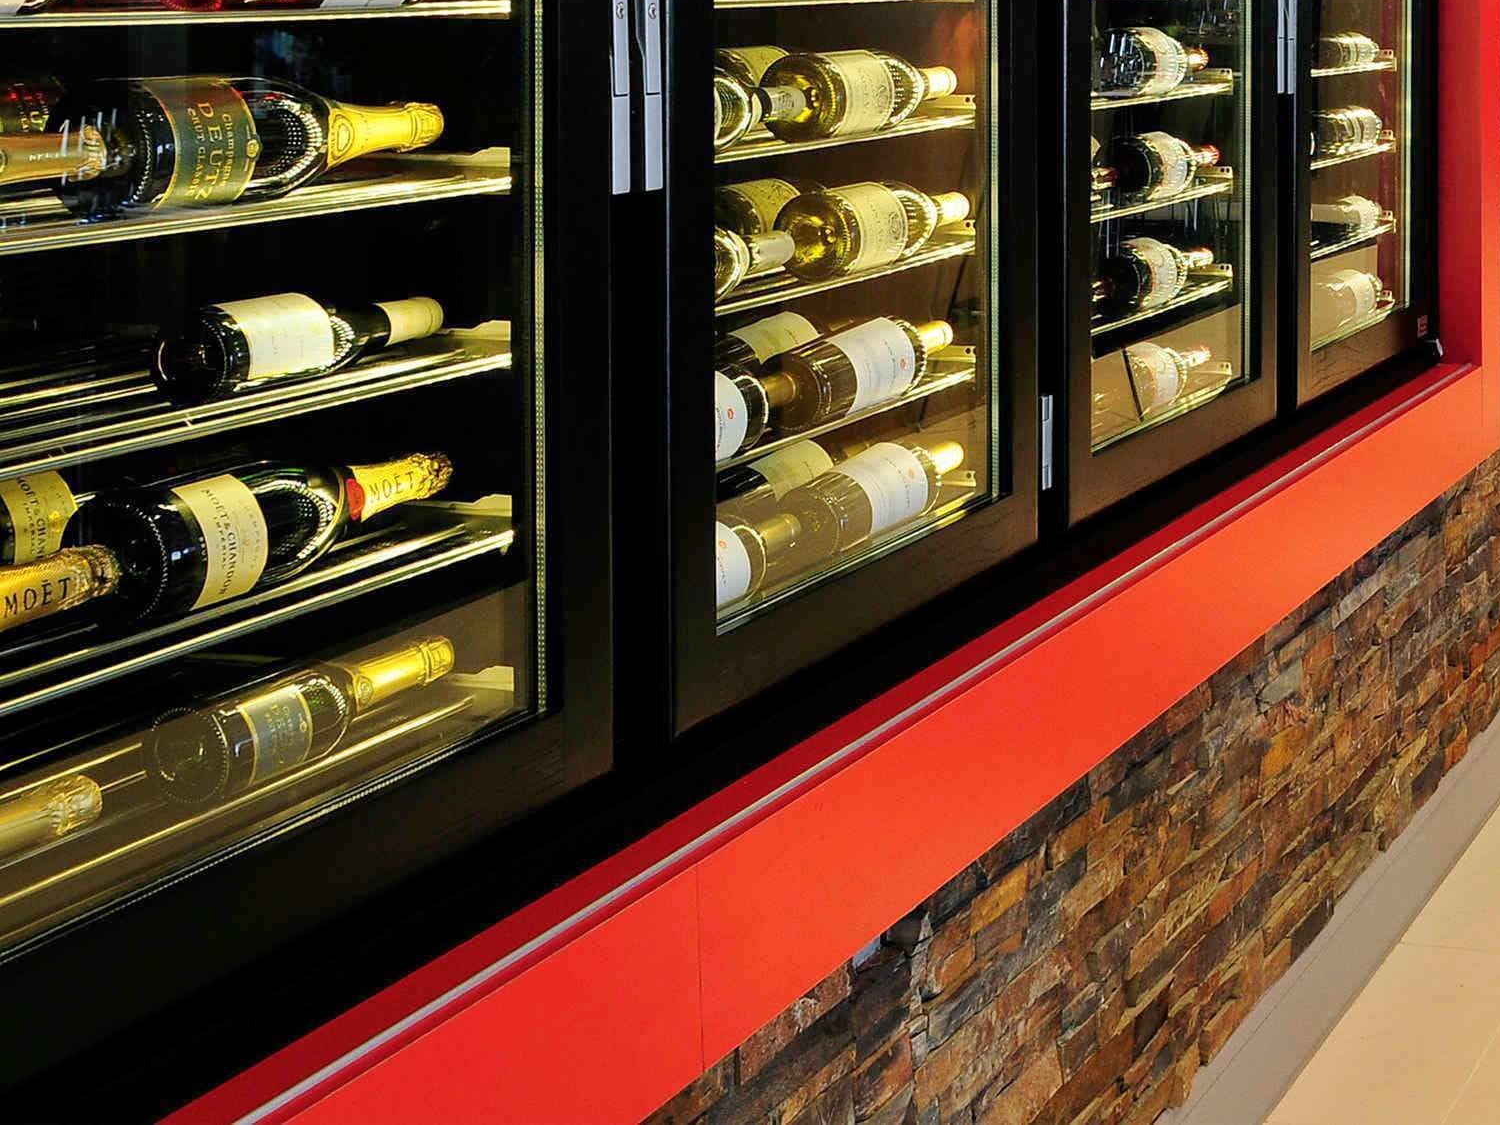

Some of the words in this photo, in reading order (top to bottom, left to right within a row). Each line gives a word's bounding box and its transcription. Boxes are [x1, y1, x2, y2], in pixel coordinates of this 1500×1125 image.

[195, 103, 224, 200] DEUTZ
[222, 113, 234, 187] Champagne
[3, 577, 71, 618] MOËT
[218, 531, 237, 595] CHANDON
